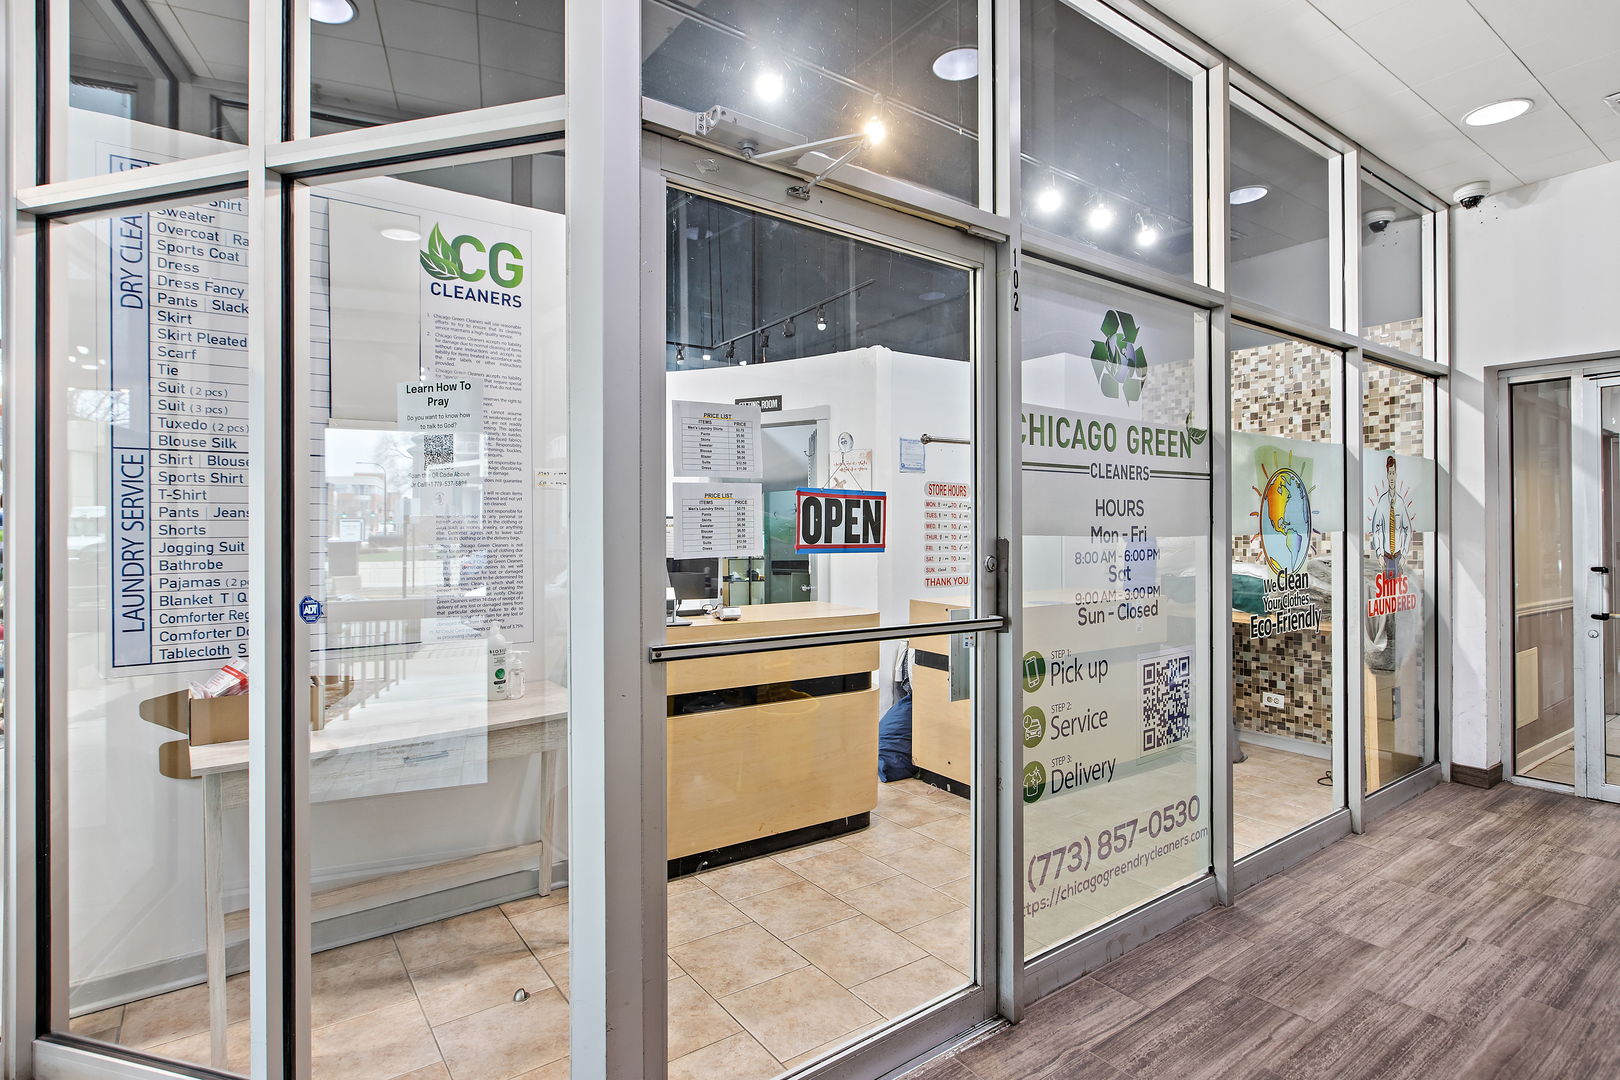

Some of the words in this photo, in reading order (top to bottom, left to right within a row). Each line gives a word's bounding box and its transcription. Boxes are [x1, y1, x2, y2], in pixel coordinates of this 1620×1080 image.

[120, 212, 143, 264] CLEA
[157, 222, 219, 241] Overcoat
[157, 240, 204, 256] Sports
[209, 248, 239, 262] Coat
[157, 257, 199, 273] Dress
[451, 235, 523, 288] CG
[120, 268, 143, 309] DRY
[157, 275, 199, 291] Dress
[205, 282, 244, 298] Fancy
[157, 293, 198, 308] Pants
[431, 282, 522, 308] CLEANERS
[157, 311, 192, 324] Skirt
[157, 329, 192, 342] Skirt
[197, 333, 247, 347] Pleated
[157, 346, 196, 359] Scarf
[157, 364, 178, 376] Tie
[157, 382, 185, 394] Suit
[406, 385, 433, 393] Learn
[436, 383, 457, 392] How
[460, 381, 471, 390] To
[158, 399, 185, 412] Suit
[428, 397, 449, 408] Pray
[762, 399, 777, 409] ROOM
[158, 418, 207, 430] Tuxedo
[159, 435, 206, 447] Blouse
[212, 438, 237, 449] Silk
[1127, 425, 1192, 458] GREEN
[159, 454, 192, 465] Shirt
[159, 472, 205, 485] Sports
[211, 473, 244, 483] Shirt
[1090, 462, 1149, 482] CLEANERS
[122, 454, 145, 531] SERVICE
[159, 489, 207, 500] T-Shirt
[929, 484, 946, 495] STORE
[948, 485, 966, 496] HOURS
[159, 507, 199, 518] Pants
[1096, 499, 1144, 516] HOURS
[802, 497, 881, 544] OPEN
[159, 525, 206, 535] Shorts
[1091, 526, 1119, 544] Mon
[1131, 526, 1146, 542] Fri
[159, 542, 214, 555] Jogging
[219, 541, 245, 552] Suit
[1075, 552, 1099, 564] 8:00
[1101, 550, 1116, 563] AM
[1124, 549, 1145, 562] 6:00
[1147, 549, 1160, 560] PM
[160, 560, 223, 571] Bathrobe
[1109, 565, 1131, 582] Sat
[1264, 579, 1276, 593] We
[1277, 568, 1308, 591] Clean
[122, 537, 145, 632] LAUNDRY
[160, 577, 221, 591] Pajamas
[926, 578, 951, 587] THANK
[1376, 571, 1408, 598] Shirts
[160, 594, 213, 606] Blanket
[1075, 592, 1099, 605] 9:00
[1101, 590, 1116, 603] AM
[1125, 588, 1145, 600] 3:00
[1148, 586, 1160, 596] PM
[1264, 596, 1281, 612] Your
[1283, 593, 1309, 608] Clothes
[304, 605, 317, 614] ADT
[1368, 594, 1416, 616] LAUNDERED
[159, 612, 224, 625] Comforter
[1078, 608, 1104, 626] Sun
[1118, 601, 1158, 620] Closed
[1251, 606, 1322, 638] Eco-Friendly
[160, 629, 232, 642] Comforter
[160, 645, 230, 660] Tablecloth
[1051, 650, 1066, 660] STEP
[1051, 658, 1083, 687] Pick
[1088, 659, 1108, 683] up
[1051, 703, 1066, 714] STEP
[1067, 702, 1072, 711] 2:
[1051, 709, 1108, 740] Service
[1052, 756, 1066, 768] STEP
[1067, 755, 1072, 764] 3:
[1051, 758, 1116, 794] Delivery
[1028, 836, 1091, 893] (773)
[1097, 795, 1200, 860] 857-0530
[1024, 827, 1207, 918] tps://chicagogreendrycleaners.com
